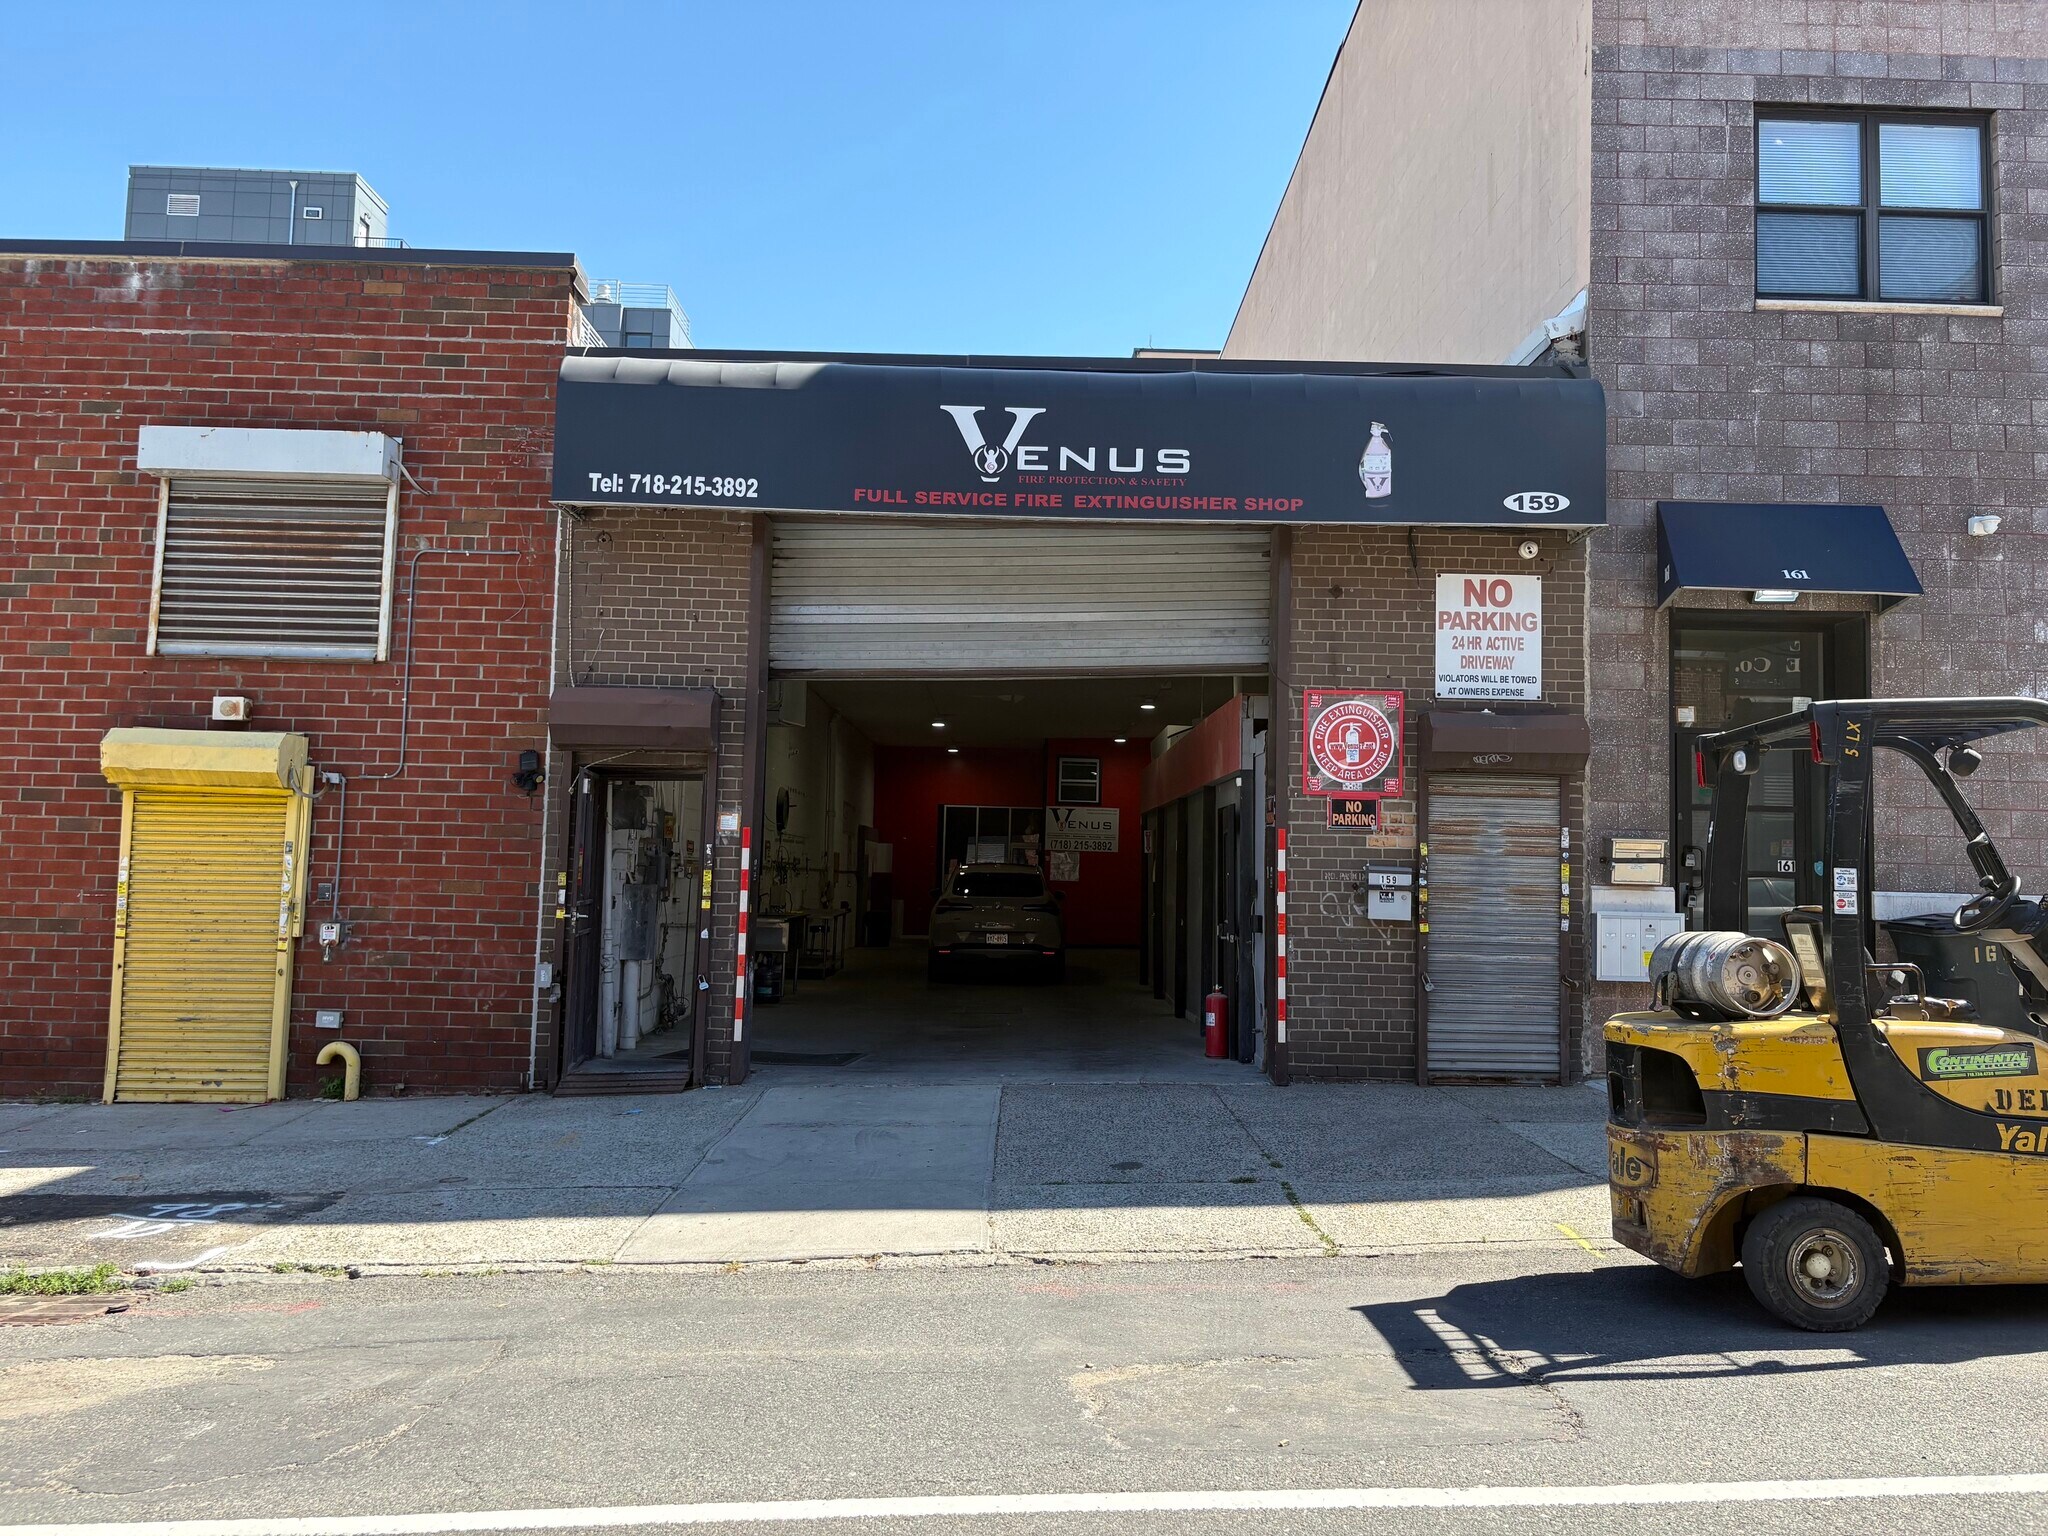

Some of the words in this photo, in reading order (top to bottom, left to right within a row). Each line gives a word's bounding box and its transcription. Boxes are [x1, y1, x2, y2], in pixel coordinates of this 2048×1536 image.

[940, 404, 1191, 482] VENUS
[589, 472, 623, 493] Tel:
[630, 473, 758, 498] 718-215-3892
[1018, 475, 1046, 484] FIRE
[1049, 476, 1127, 486] PROTECTION
[1128, 477, 1138, 486] &
[1141, 477, 1188, 487] SAFETY
[854, 488, 908, 504] FULL
[914, 491, 1007, 506] SERVICE
[1014, 493, 1062, 508] FIRE
[1073, 495, 1238, 511] EXTINGUISHER
[1244, 497, 1304, 511] SHOP
[1511, 494, 1560, 512] 159
[1781, 569, 1811, 580] 161
[1463, 578, 1513, 608] NO
[1438, 610, 1538, 632] PARKING
[1452, 635, 1465, 650] 24
[1467, 636, 1482, 650] HR
[1486, 636, 1525, 651] ACTIVE
[1460, 655, 1515, 670] DRIVEWAY
[1438, 674, 1479, 683] VIOLATORS
[1481, 675, 1498, 683] WILL
[1500, 675, 1509, 683] BE
[1511, 675, 1538, 684] TOWED
[1448, 687, 1456, 695] AT
[1458, 687, 1490, 696] OWNERS
[1492, 688, 1525, 697] EXPENSE
[1315, 718, 1330, 740] FIRE
[1328, 705, 1389, 739] EXTINGUISHER
[1846, 720, 1861, 742] LX
[1845, 748, 1859, 757] 5
[1317, 752, 1338, 773] KEEP
[1337, 769, 1363, 780] AREA
[1364, 751, 1388, 776] CLEAR
[1345, 800, 1362, 813] NO
[1049, 808, 1112, 831] VENUS
[1332, 813, 1376, 826] PARKING
[1050, 840, 1072, 850] (718)
[1073, 840, 1112, 851] 215-3892
[1778, 860, 1795, 872] 161
[1381, 875, 1397, 884] 159
[1927, 1048, 2030, 1074] CONTINENTAL
[1611, 1143, 1642, 1182] ale
